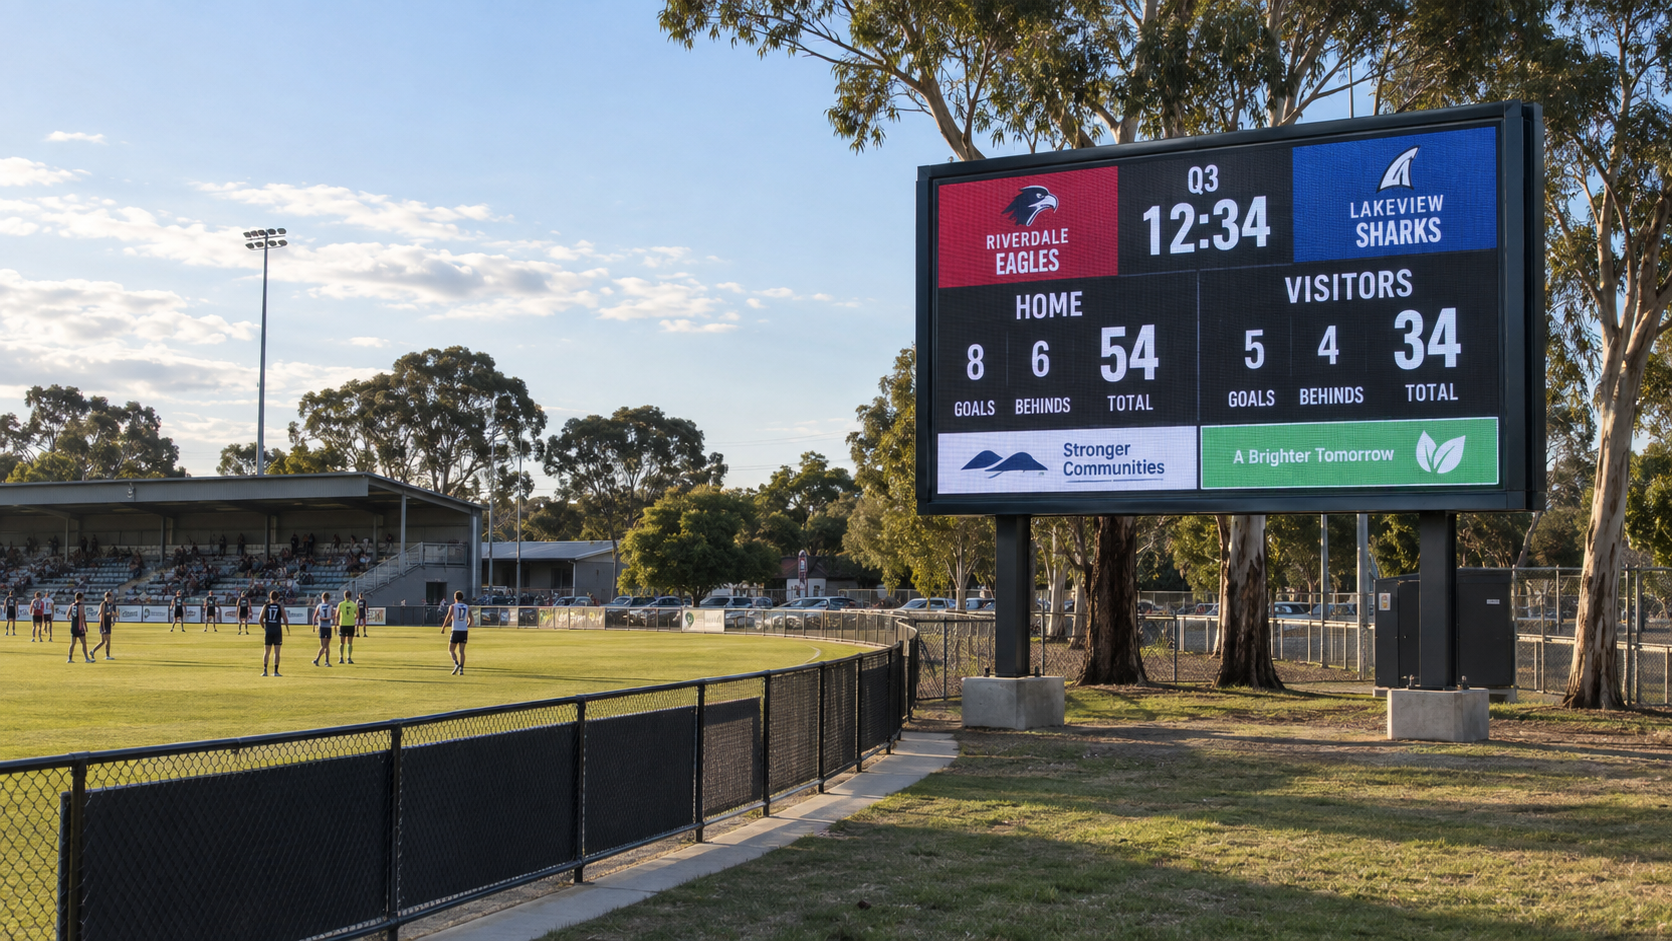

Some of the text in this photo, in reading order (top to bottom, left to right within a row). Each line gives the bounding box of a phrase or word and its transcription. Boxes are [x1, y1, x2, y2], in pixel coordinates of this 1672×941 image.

[1187, 164, 1219, 195] Q3
[1350, 194, 1444, 221] LAKEVIEW
[1143, 193, 1272, 256] 12:34
[1355, 215, 1442, 248] SHARKS
[986, 227, 1069, 250] RIVERDALE
[995, 248, 1060, 276] EAGLES
[1284, 268, 1413, 304] VISITORS
[1015, 290, 1083, 320] HOME
[1244, 307, 1462, 370] 5 4 34
[966, 324, 1159, 383] 8 6 54
[954, 393, 1154, 417] GOALS BEHINDS TOTAL
[1228, 382, 1459, 408] GOALS BEHINDS TOTAL
[1063, 442, 1131, 461] Stronger
[1233, 447, 1395, 467] A Brighter Tomorrow
[1063, 458, 1165, 476] Communities
[268, 608, 279, 620] 17
